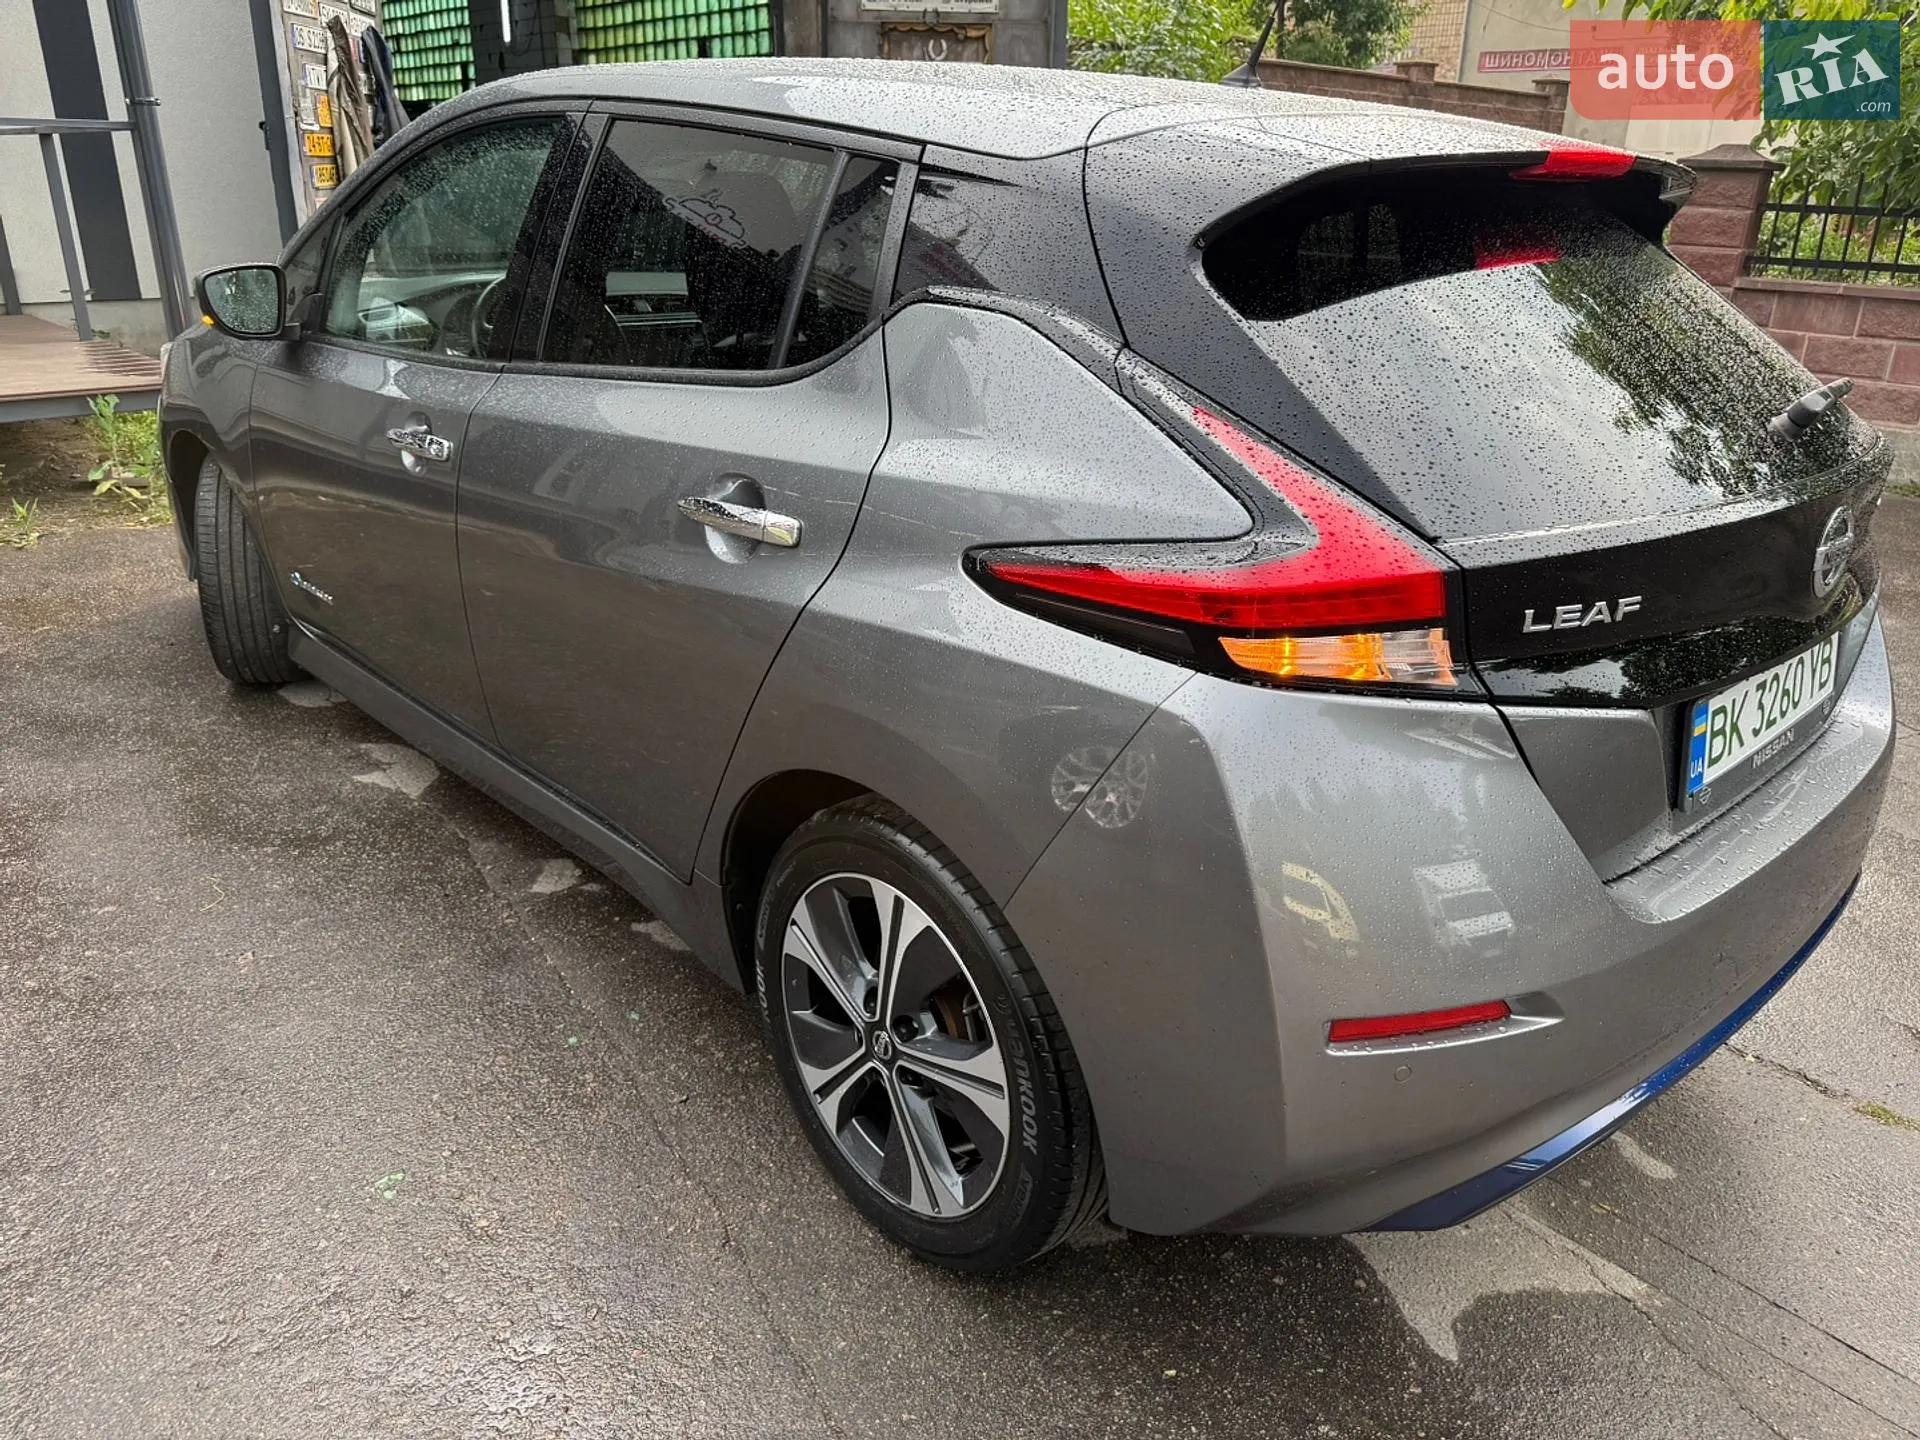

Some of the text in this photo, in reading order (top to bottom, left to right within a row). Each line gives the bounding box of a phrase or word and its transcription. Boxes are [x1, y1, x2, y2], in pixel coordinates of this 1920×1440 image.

[1522, 595, 1642, 633] LEAF
[1708, 637, 1834, 768] BK 3260 YB
[1690, 757, 1704, 778] UA
[1752, 728, 1796, 769] NISSAN
